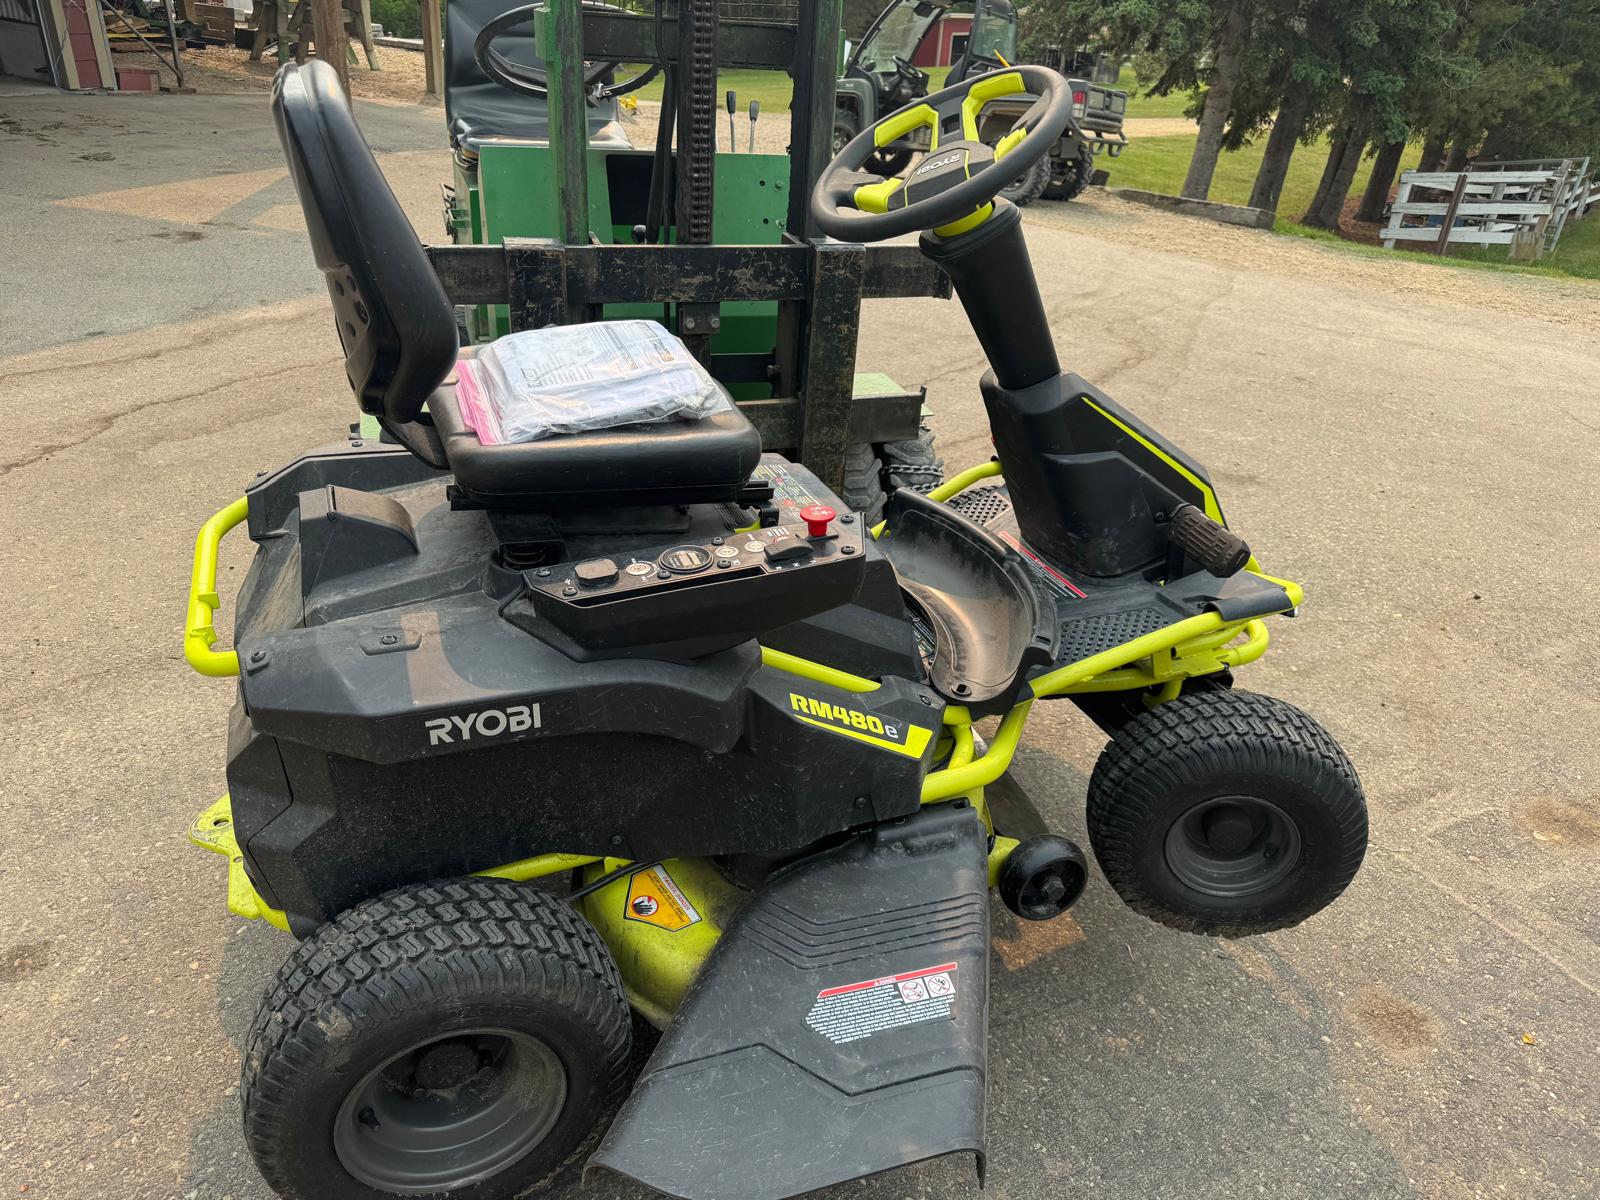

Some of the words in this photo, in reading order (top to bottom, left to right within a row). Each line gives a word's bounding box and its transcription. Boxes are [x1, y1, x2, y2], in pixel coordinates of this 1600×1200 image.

[916, 154, 960, 176] RYOBI
[424, 702, 542, 746] RYOBI
[789, 692, 899, 739] RM480e
